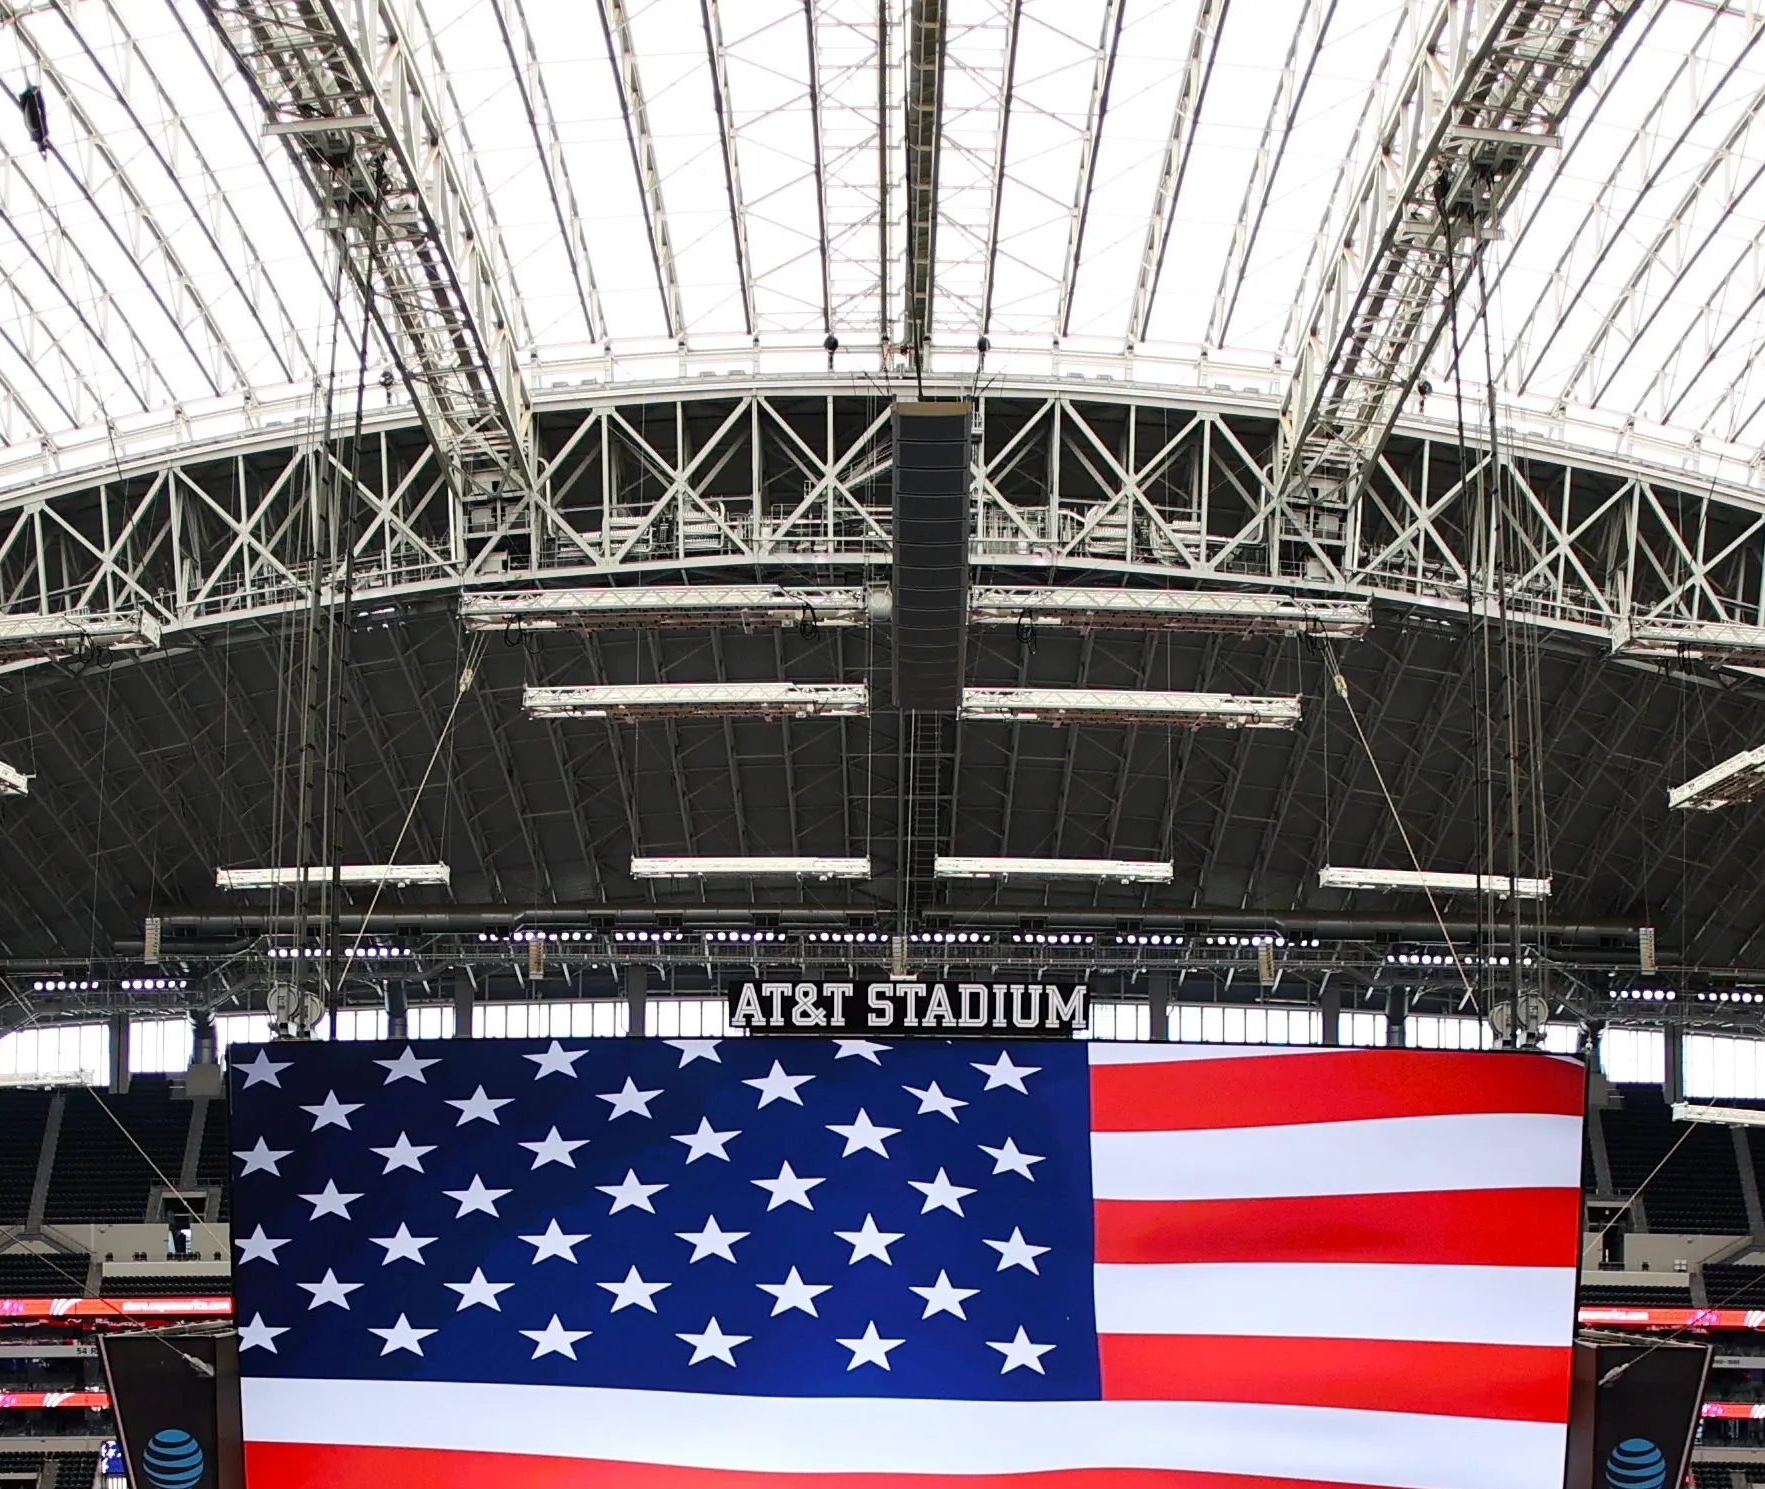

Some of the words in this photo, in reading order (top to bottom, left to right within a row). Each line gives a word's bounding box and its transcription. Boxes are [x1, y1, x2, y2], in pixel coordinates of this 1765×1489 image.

[732, 983, 853, 1027] AT&T
[868, 983, 1087, 1029] STADIUM
[123, 1300, 231, 1312] store.copaamerica.com
[76, 1347, 88, 1355] 54
